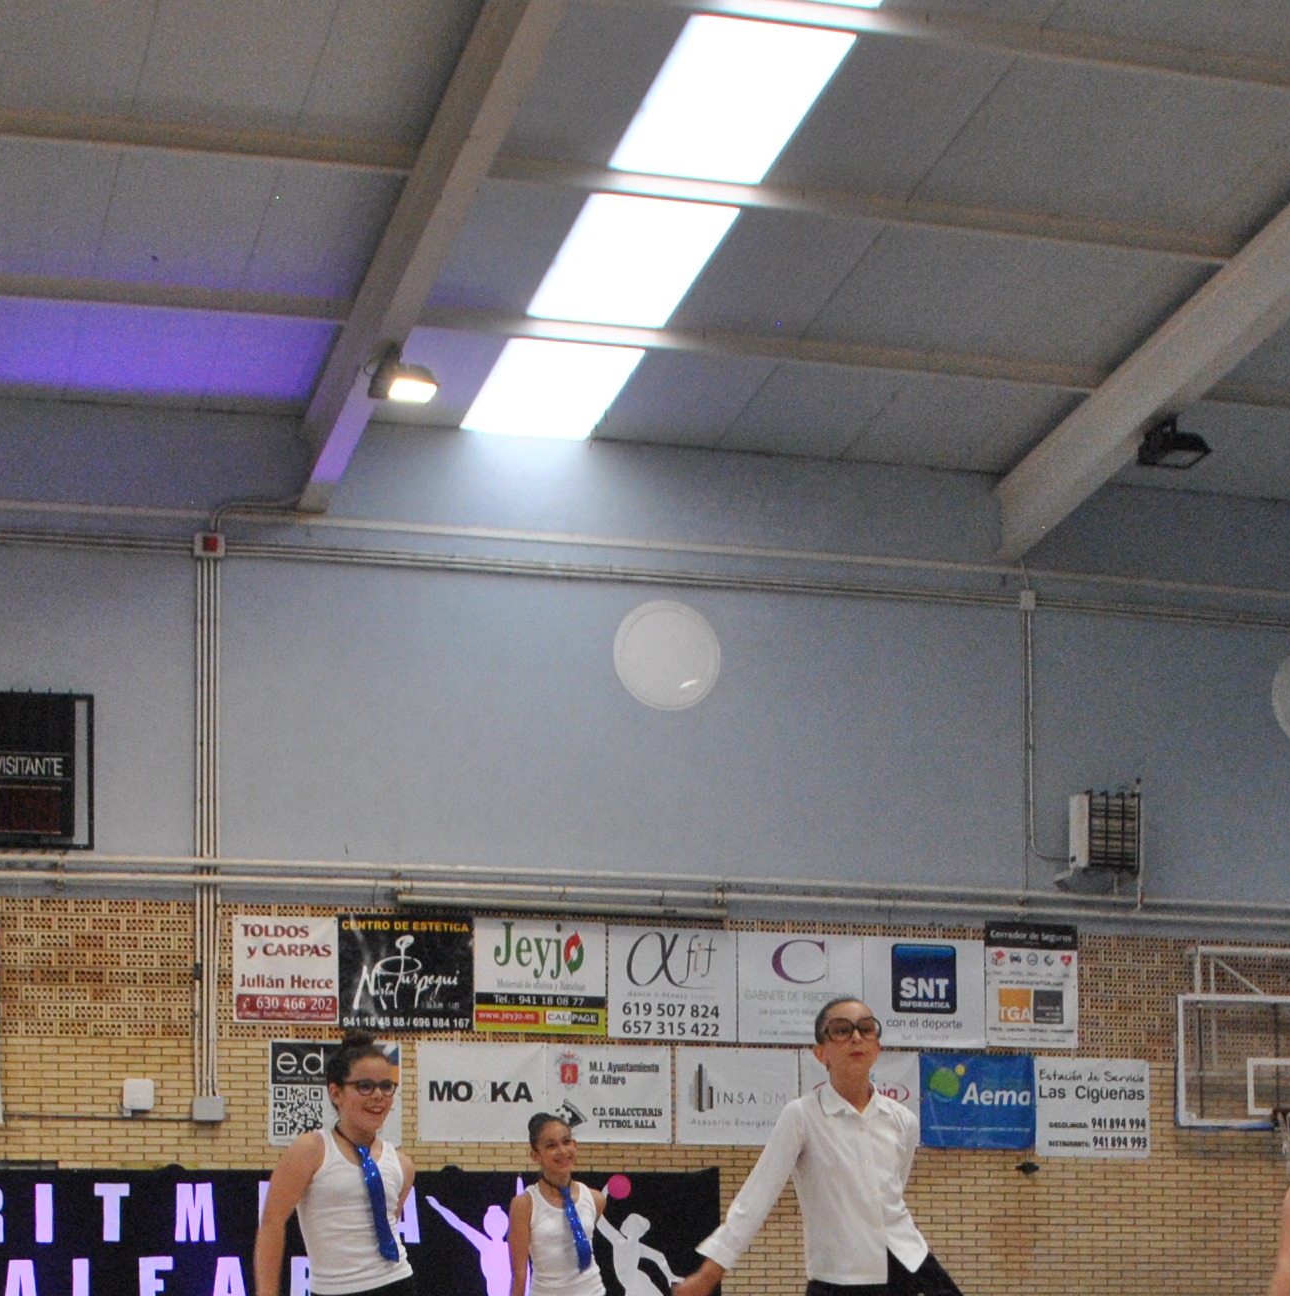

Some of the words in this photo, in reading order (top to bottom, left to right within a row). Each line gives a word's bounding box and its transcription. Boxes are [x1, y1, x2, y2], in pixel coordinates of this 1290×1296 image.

[241, 923, 310, 938] TOLDOS
[342, 920, 390, 930] CENTRO
[394, 921, 409, 931] DE
[412, 921, 469, 932] ESTETICA
[247, 946, 257, 958] y
[262, 943, 332, 957] CARPAS
[494, 921, 584, 979] Jeyjo
[771, 939, 826, 984] C
[240, 973, 285, 988] Julián
[290, 974, 333, 989] Herce
[900, 977, 949, 999] SNT
[256, 996, 279, 1010] 630
[283, 997, 306, 1010] 466
[310, 997, 333, 1010] 202
[519, 995, 536, 1005] 941
[542, 996, 553, 1005] 18
[557, 997, 568, 1006] 08
[573, 998, 584, 1006] 77
[479, 1012, 535, 1021] www.jeyjo.es
[622, 1001, 652, 1016] 619
[656, 1003, 686, 1017] 507
[690, 1004, 720, 1019] 824
[1000, 1006, 1032, 1020] TGA
[343, 1017, 360, 1027] 941
[365, 1017, 376, 1027] 18
[378, 1017, 391, 1027] 48
[393, 1017, 405, 1027] 88
[413, 1018, 430, 1028] 696
[433, 1018, 450, 1028] 884
[454, 1018, 470, 1029] 167
[622, 1020, 652, 1034] 657
[657, 1021, 686, 1036] 315
[690, 1023, 720, 1037] 422
[886, 1019, 906, 1027] con
[909, 1018, 918, 1027] el
[922, 1017, 963, 1030] deporte
[608, 1062, 659, 1073] Ayuntamiento
[589, 1075, 598, 1085] de
[601, 1075, 626, 1085] Alfaro
[1039, 1068, 1083, 1081] Estación
[1087, 1070, 1101, 1082] de
[1103, 1070, 1145, 1083] Servicio
[1038, 1085, 1066, 1099] Las
[1075, 1085, 1145, 1104] Cigüeñas
[592, 1107, 607, 1117] C.D.
[599, 1119, 632, 1128] FUTBOL
[635, 1120, 656, 1129] SALA
[1091, 1117, 1107, 1129] 941
[1109, 1118, 1126, 1129] 894
[1129, 1118, 1146, 1130] 994
[1092, 1136, 1109, 1148] 941
[1111, 1136, 1128, 1148] 894
[1130, 1136, 1147, 1149] 993
